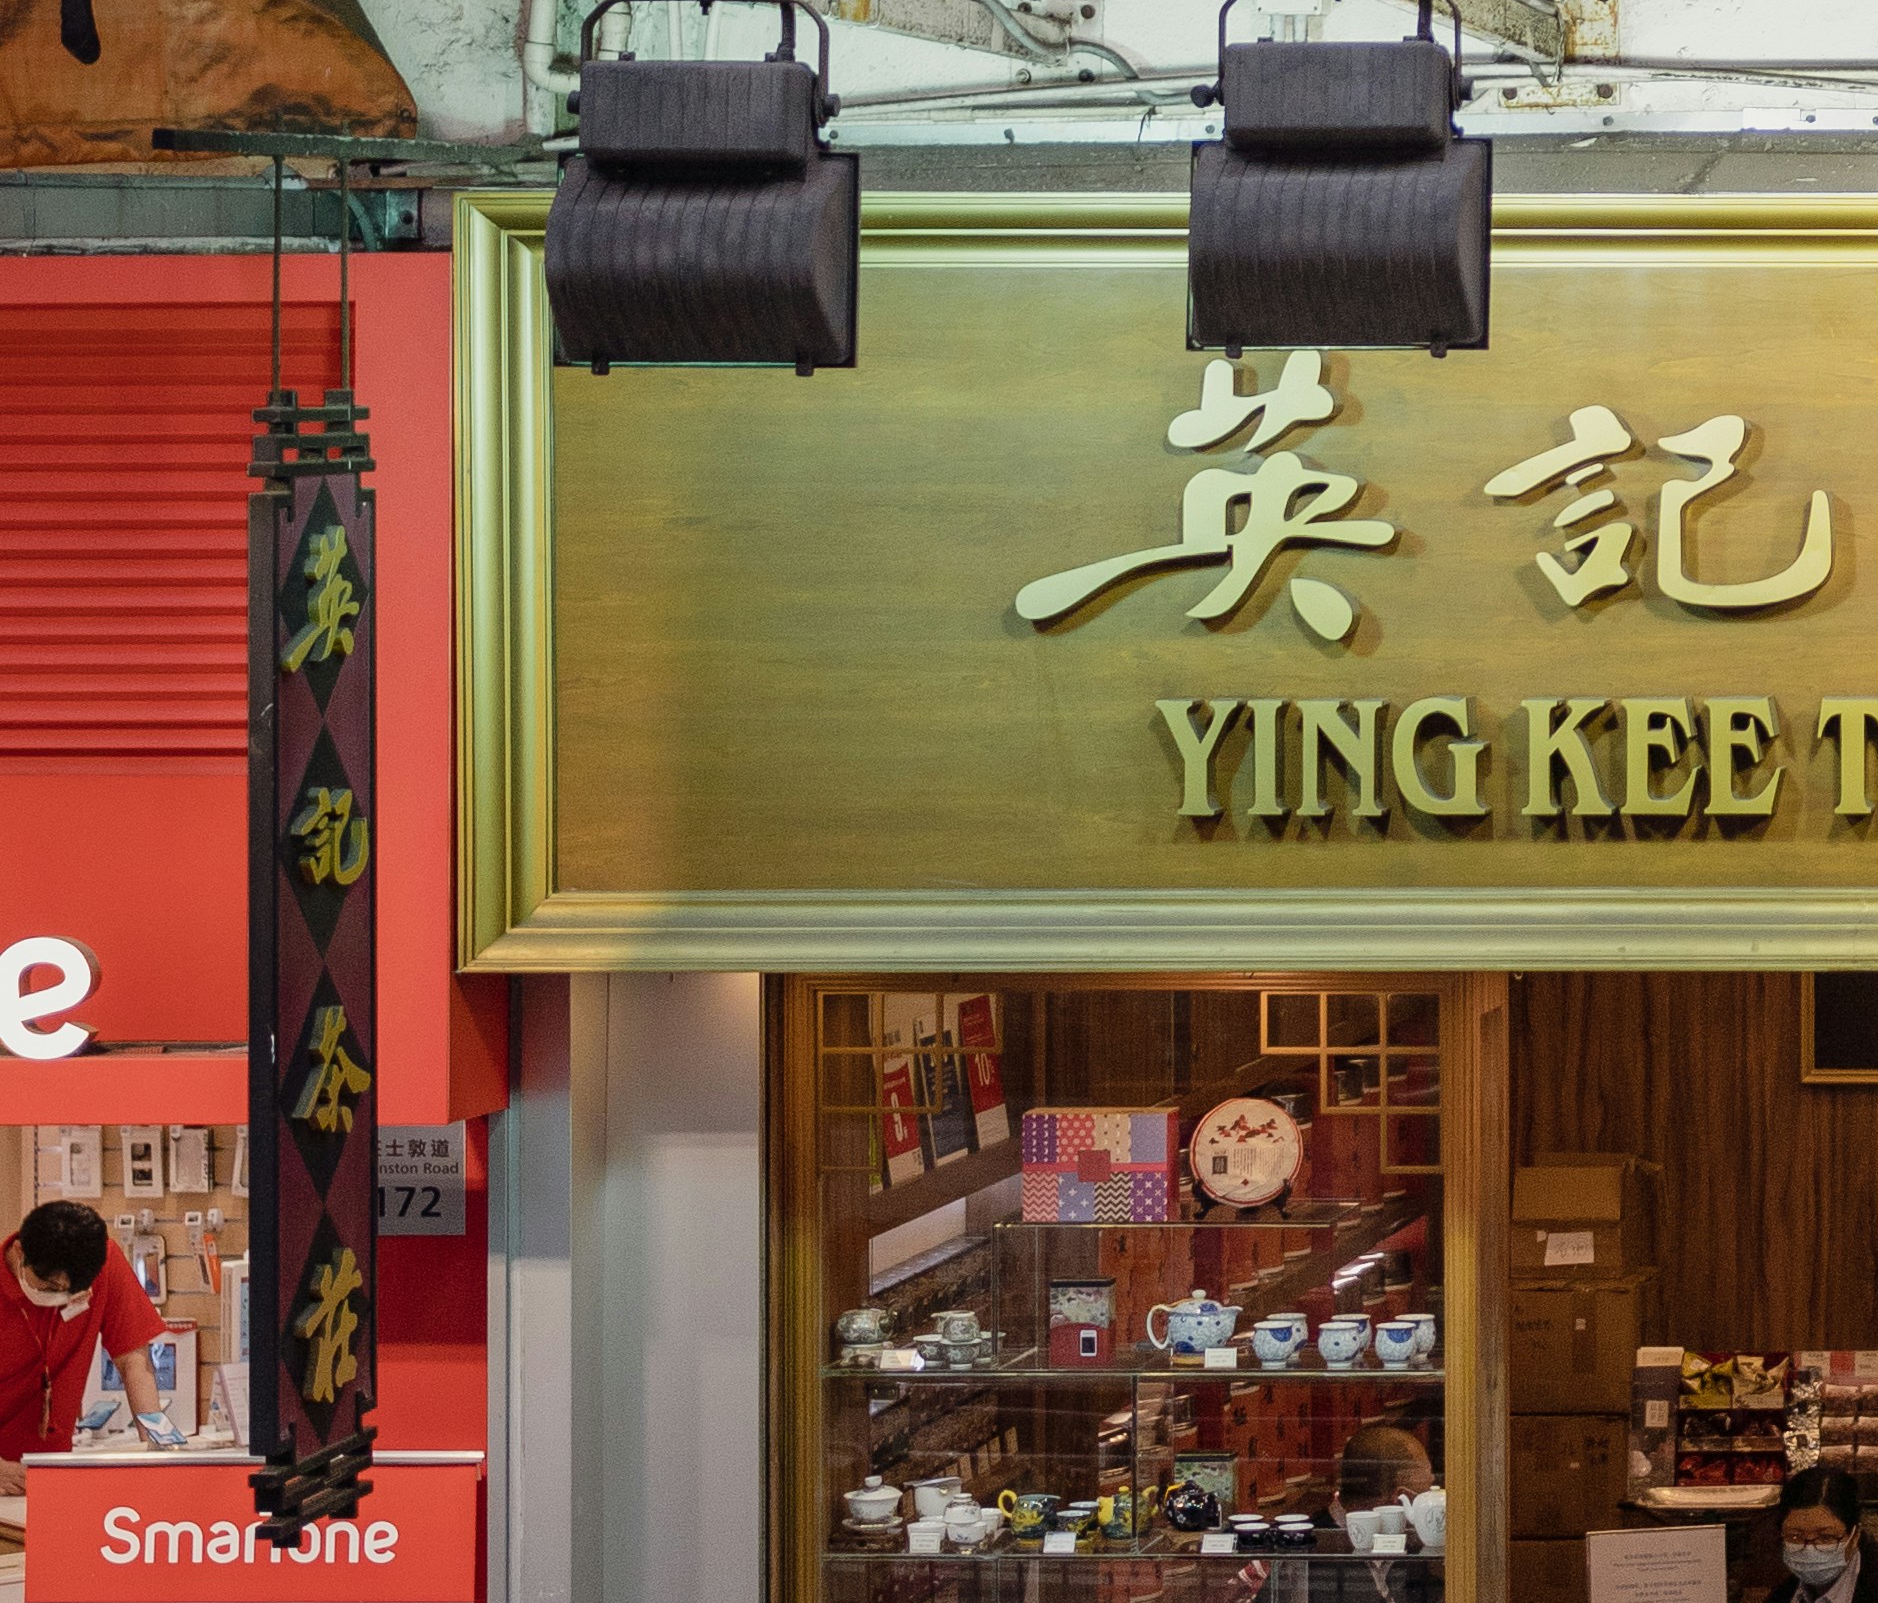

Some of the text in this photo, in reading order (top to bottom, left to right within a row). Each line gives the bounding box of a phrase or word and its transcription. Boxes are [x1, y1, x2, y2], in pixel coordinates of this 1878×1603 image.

[1153, 694, 1483, 821] YING
[1519, 694, 1780, 818] KEE
[379, 1162, 459, 1174] nston Road
[378, 1186, 441, 1218] 172
